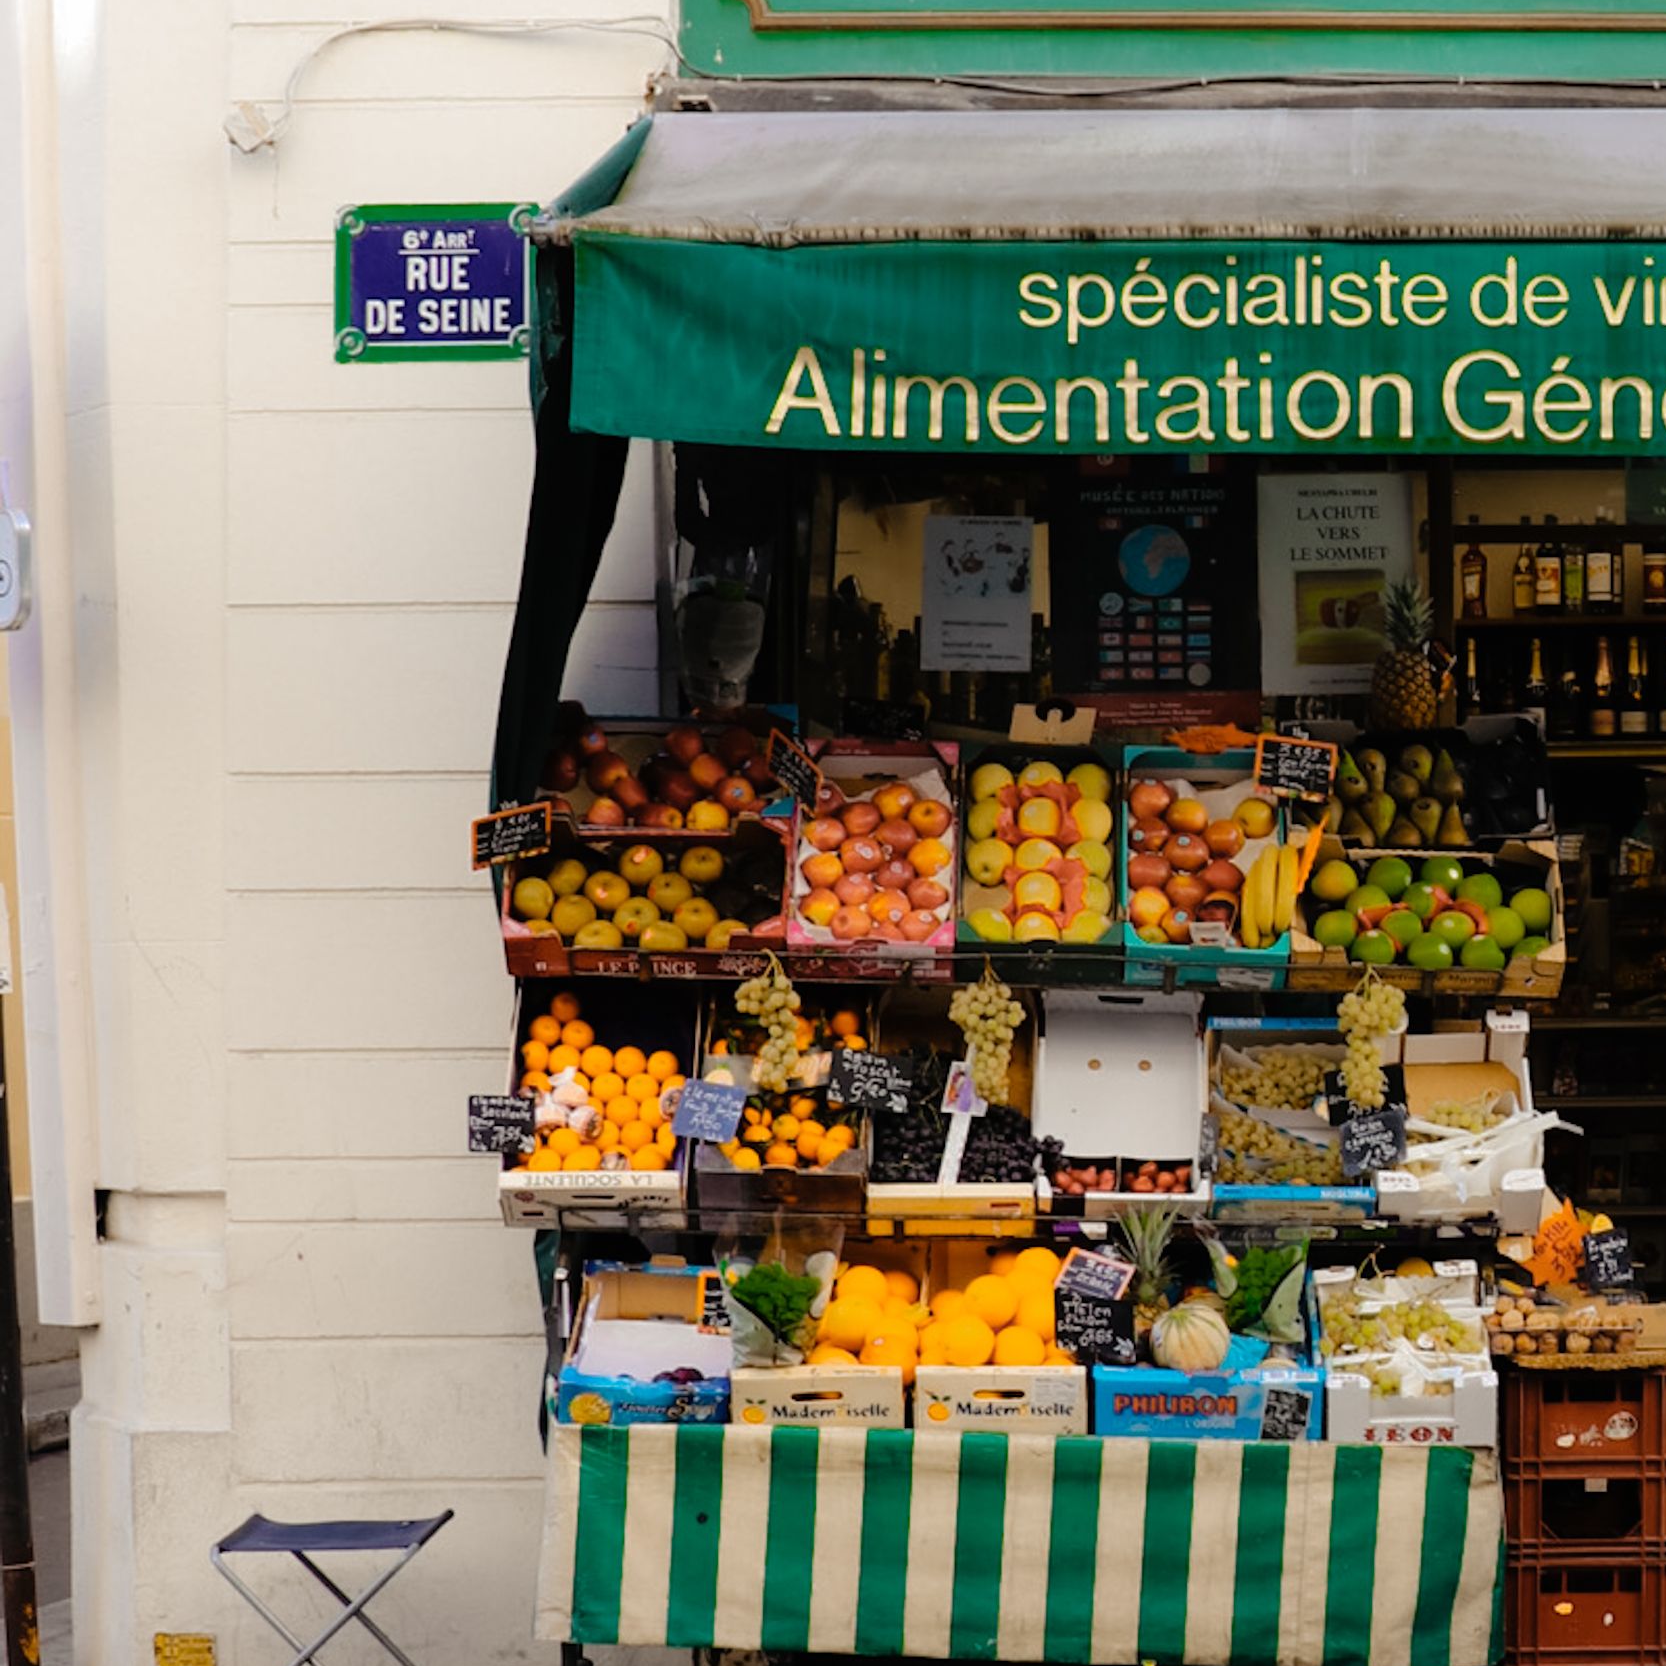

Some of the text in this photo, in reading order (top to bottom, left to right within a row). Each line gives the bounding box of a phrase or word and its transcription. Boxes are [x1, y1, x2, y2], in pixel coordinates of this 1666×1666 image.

[406, 255, 471, 292] RUE
[1017, 254, 1448, 346] spécialiste
[1469, 255, 1570, 328] de
[365, 297, 512, 334] DE SEINE
[764, 346, 1415, 445] Alimentation
[1297, 505, 1380, 521] LA CHUTE
[1317, 526, 1360, 541] VERS
[1290, 546, 1389, 562] LE SOMMET
[597, 959, 698, 975] LE PINCE
[1113, 1392, 1238, 1416] PHILIBON
